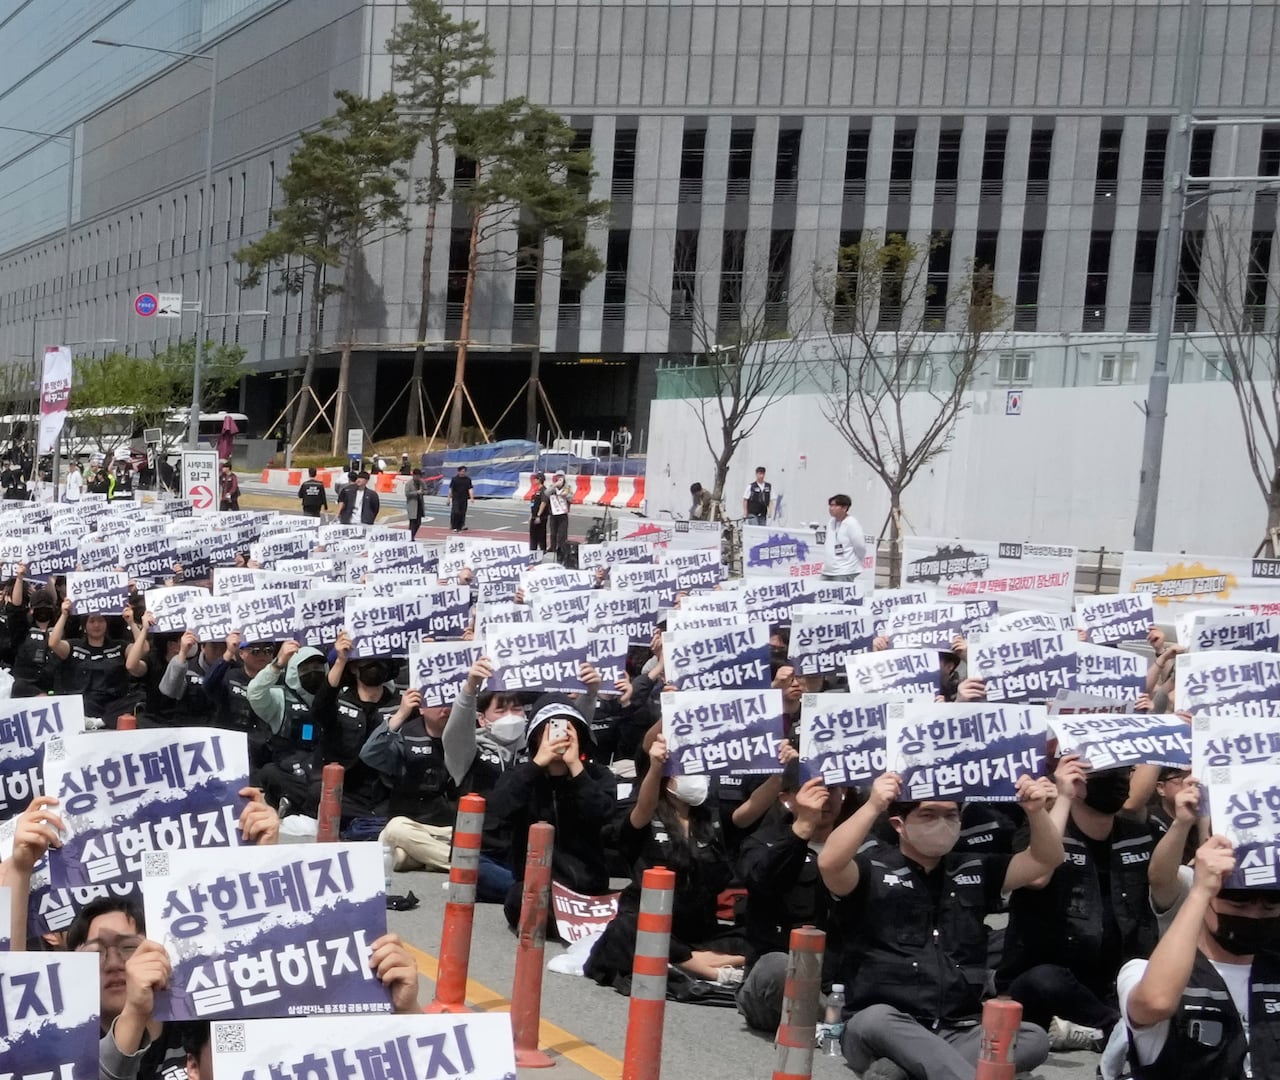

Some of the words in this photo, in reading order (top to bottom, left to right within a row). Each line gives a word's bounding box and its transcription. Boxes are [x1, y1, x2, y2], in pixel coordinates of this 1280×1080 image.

[191, 471, 210, 481] 입구
[26, 539, 72, 557] 상한폐지
[123, 539, 170, 559] 상한폐지
[1000, 544, 1022, 558] NSEU
[29, 557, 76, 575] 실현하자
[127, 558, 176, 576] 실현하자
[72, 576, 117, 594] 상한폐지
[74, 594, 124, 614] 실현하자
[351, 600, 422, 628] 상한폐지
[593, 596, 647, 619] 상한폐지
[1083, 595, 1144, 621] 상한폐지
[356, 630, 423, 655] 실현하자
[494, 628, 577, 657] 상한폐지
[796, 620, 865, 650] 상한폐지
[1090, 618, 1154, 644] 실현하자
[1197, 619, 1270, 648] 상한폐지
[972, 635, 1064, 670] 상한폐지
[502, 664, 579, 690] 실현하자
[985, 665, 1075, 700] 실현하자
[671, 695, 768, 735] 상한폐지
[896, 711, 1008, 753] 상한폐지
[679, 734, 783, 774] 실현하자
[59, 737, 227, 816] 상한폐지
[910, 748, 1025, 798] 실현하자
[81, 804, 242, 884] 실현하자
[967, 834, 994, 846] SELU
[1121, 853, 1149, 866] SELU
[162, 851, 354, 938] 상한폐지
[186, 930, 376, 1016] 실현하자
[288, 1004, 346, 1014] 삼성전자노동조합
[348, 1003, 391, 1013] 공동투쟁본부
